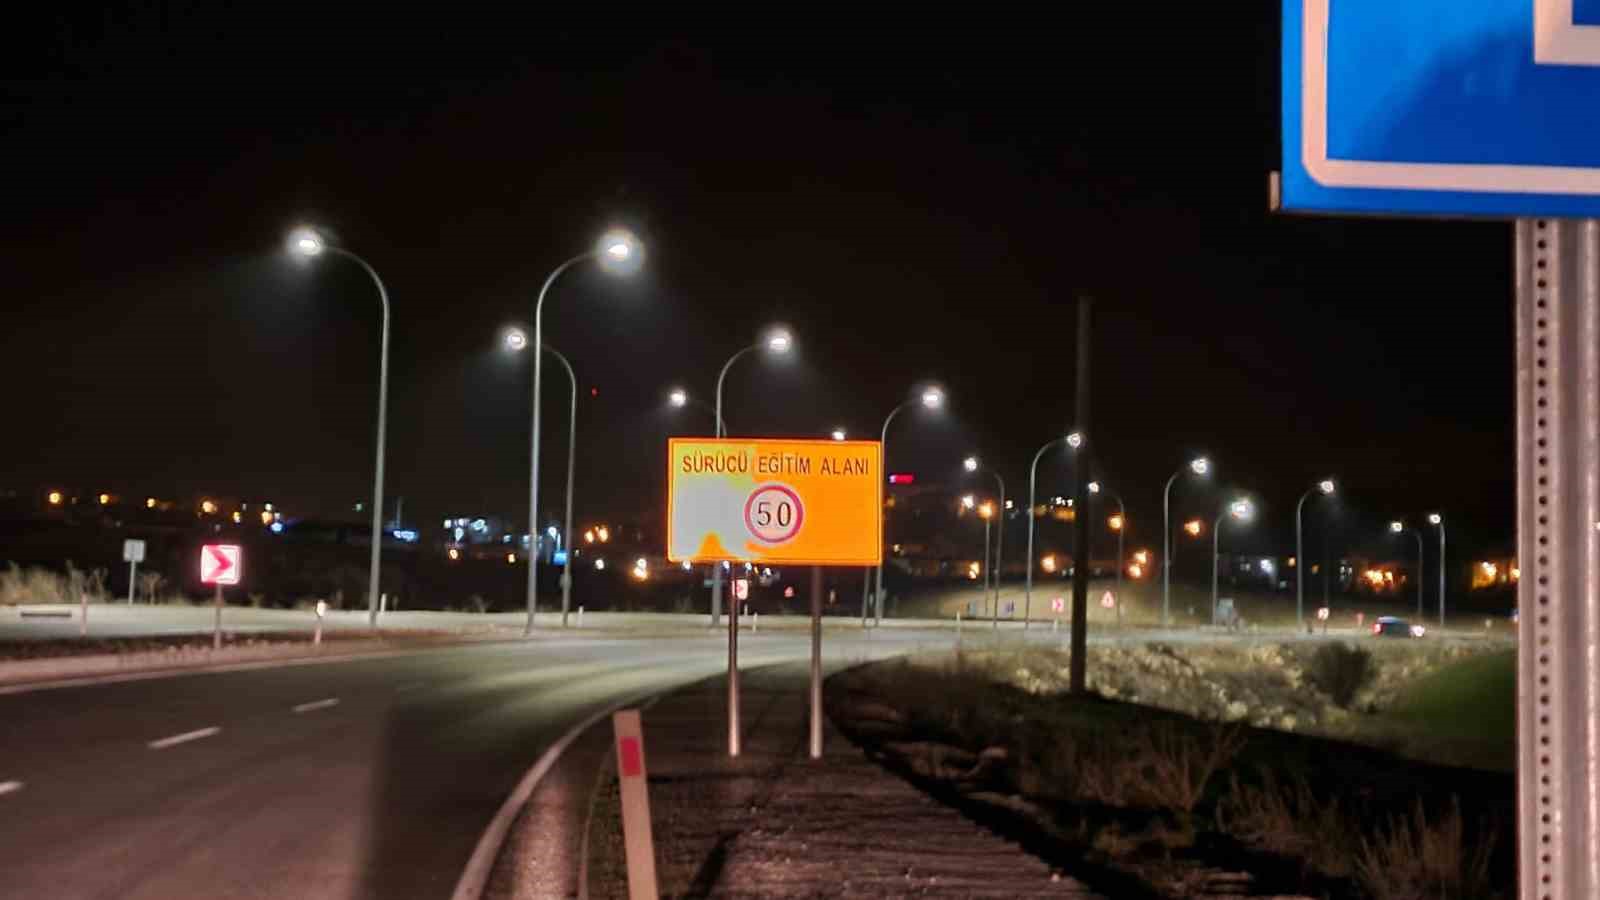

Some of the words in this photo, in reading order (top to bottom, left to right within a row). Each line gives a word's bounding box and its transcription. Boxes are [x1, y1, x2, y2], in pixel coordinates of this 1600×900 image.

[682, 449, 748, 473] SÜRÜCÜ
[758, 452, 811, 475] EĞİTİM
[820, 456, 869, 475] ALANI
[757, 501, 792, 527] 50
